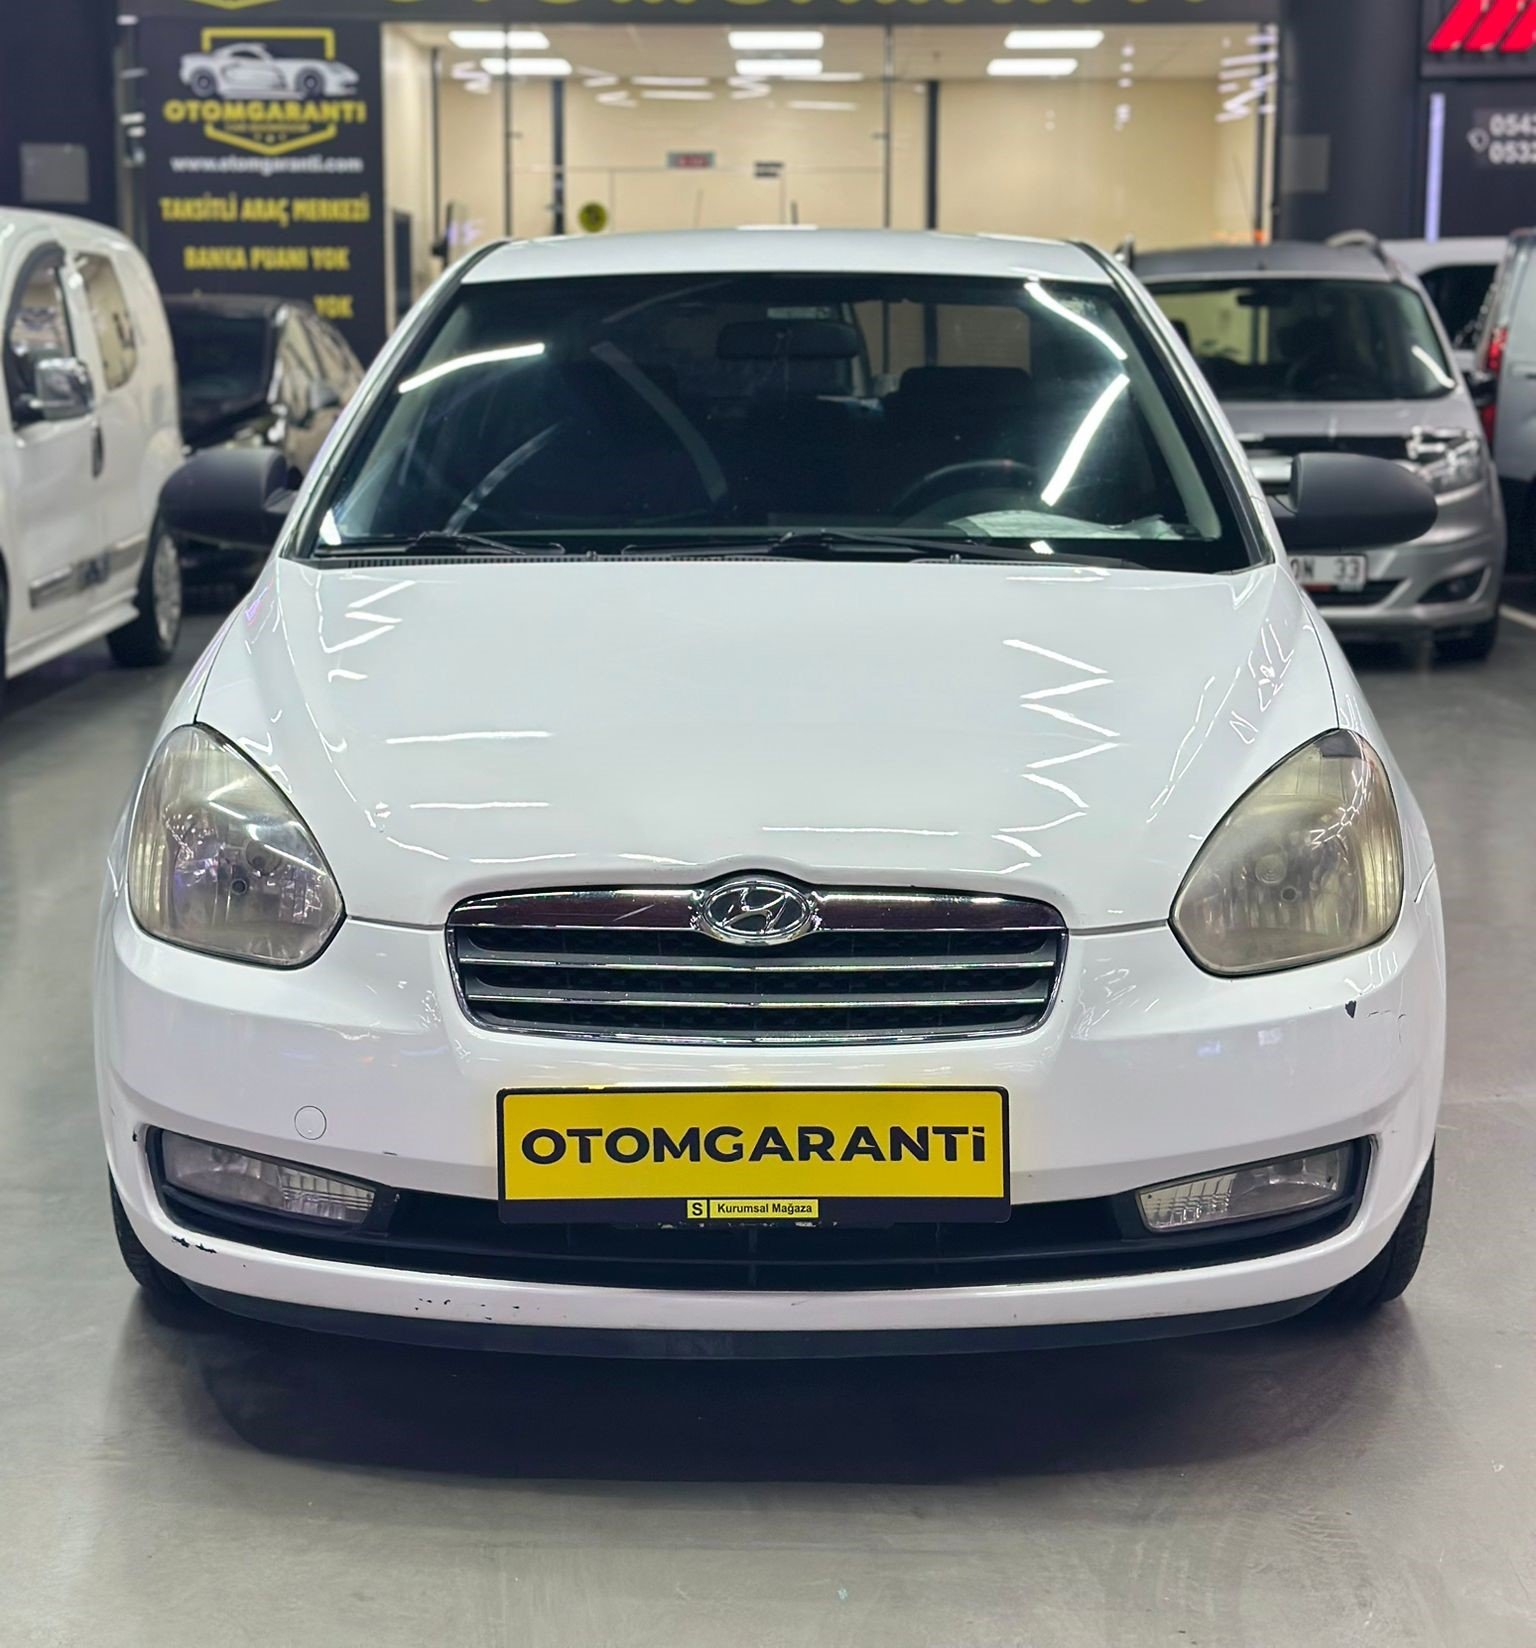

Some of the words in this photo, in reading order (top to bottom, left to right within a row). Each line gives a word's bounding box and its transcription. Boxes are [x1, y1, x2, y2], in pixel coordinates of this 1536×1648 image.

[171, 156, 364, 176] www.otomgaranti.com
[159, 192, 238, 221] TAKSİTLİ
[241, 198, 290, 228] ARAÇ
[292, 192, 371, 221] MERKEZİ
[183, 246, 247, 270] BANKA
[250, 246, 308, 270] PUANI
[311, 246, 350, 270] YOK
[314, 294, 354, 319] YOK
[1334, 557, 1361, 580] 33
[692, 1202, 703, 1216] S
[717, 1203, 769, 1213] Kurumsal
[772, 1203, 813, 1215] Mağaza
